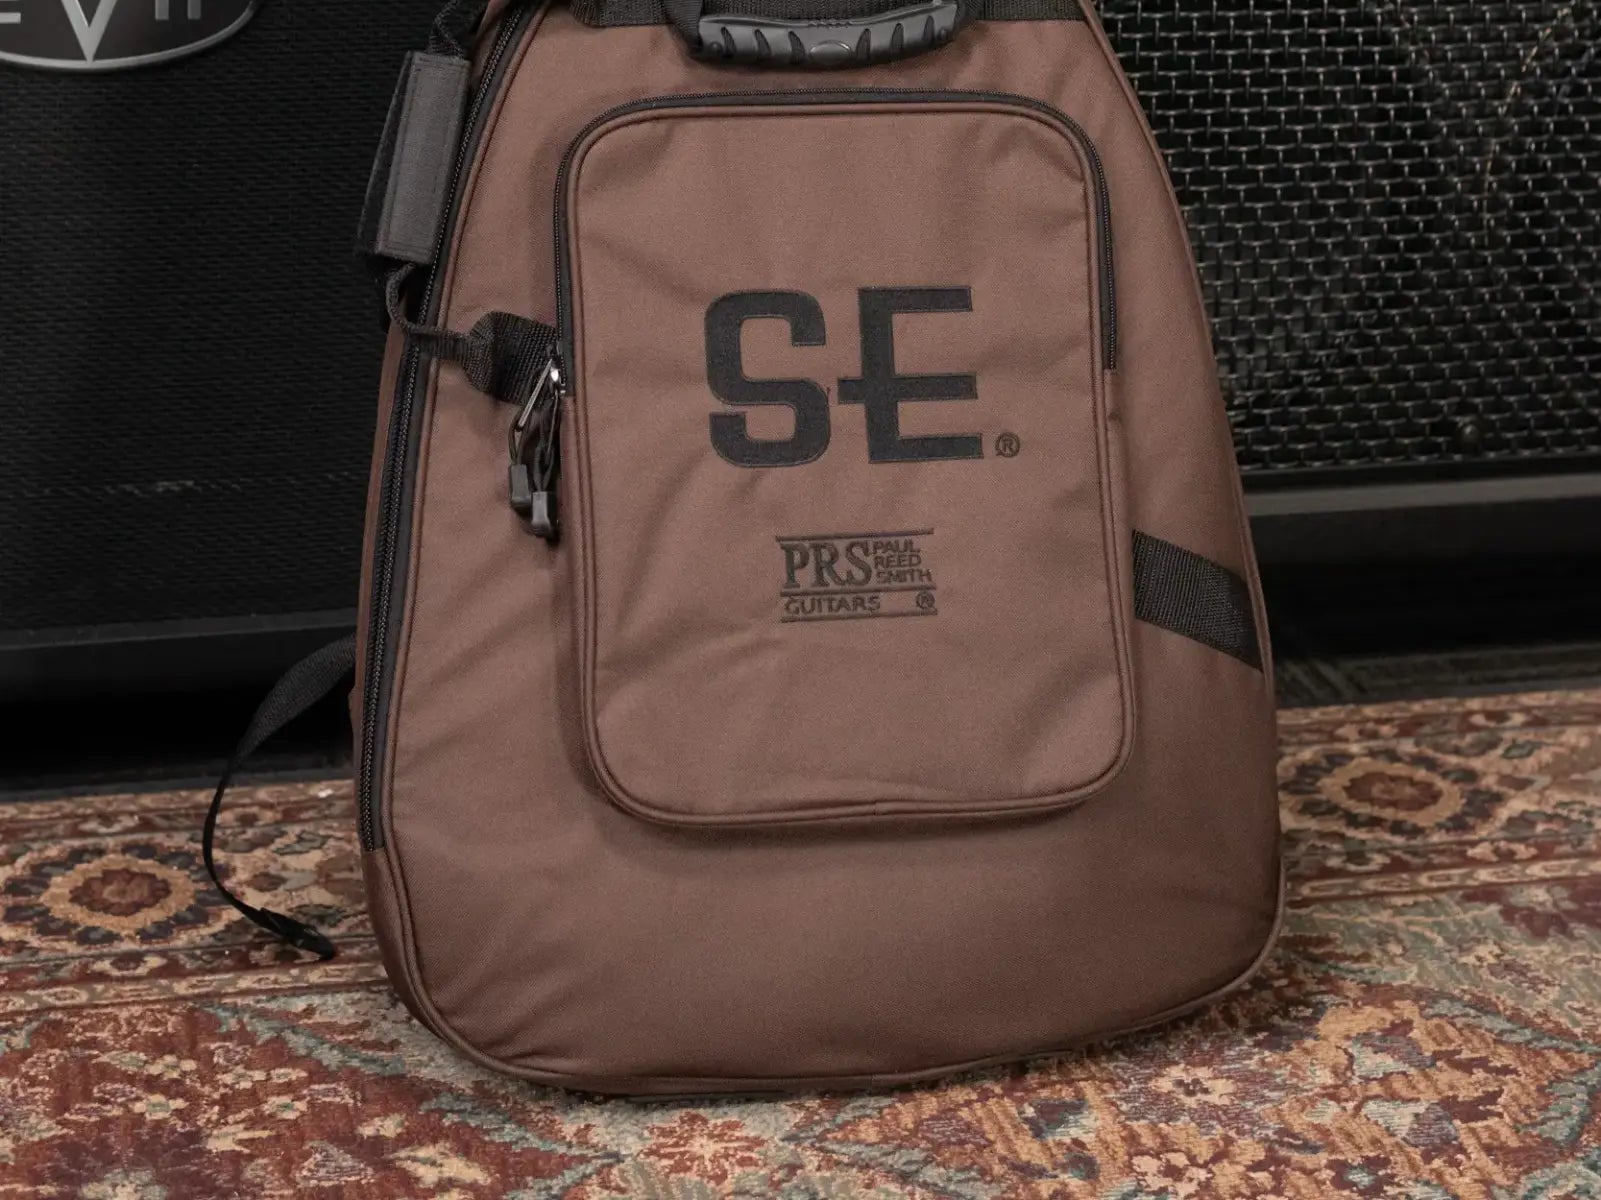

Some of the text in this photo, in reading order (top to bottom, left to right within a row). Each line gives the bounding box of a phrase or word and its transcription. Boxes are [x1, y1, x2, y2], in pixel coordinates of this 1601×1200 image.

[703, 286, 984, 468] SE
[871, 538, 920, 555] PAUL
[780, 542, 873, 588] PRS
[873, 553, 922, 568] REED
[876, 568, 933, 584] SMITH
[784, 595, 881, 615] GUITARS
